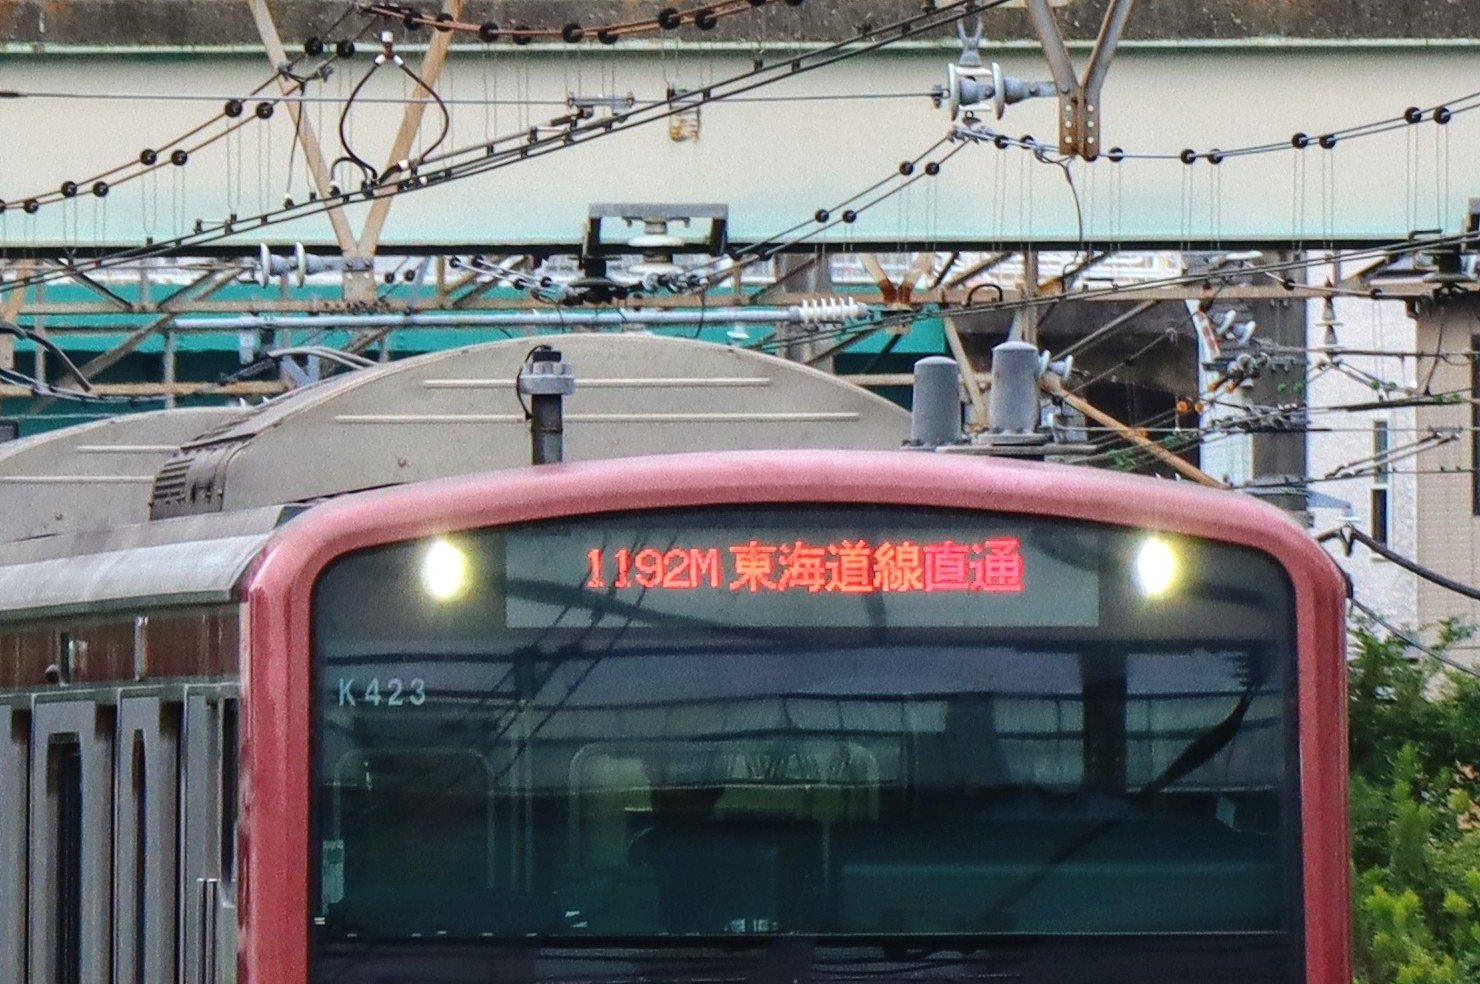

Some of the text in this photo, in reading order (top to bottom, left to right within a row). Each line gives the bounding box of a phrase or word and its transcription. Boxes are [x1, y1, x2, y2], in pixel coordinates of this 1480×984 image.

[586, 538, 1023, 592] 1192M 東海道線直通
[337, 676, 426, 707] K423
